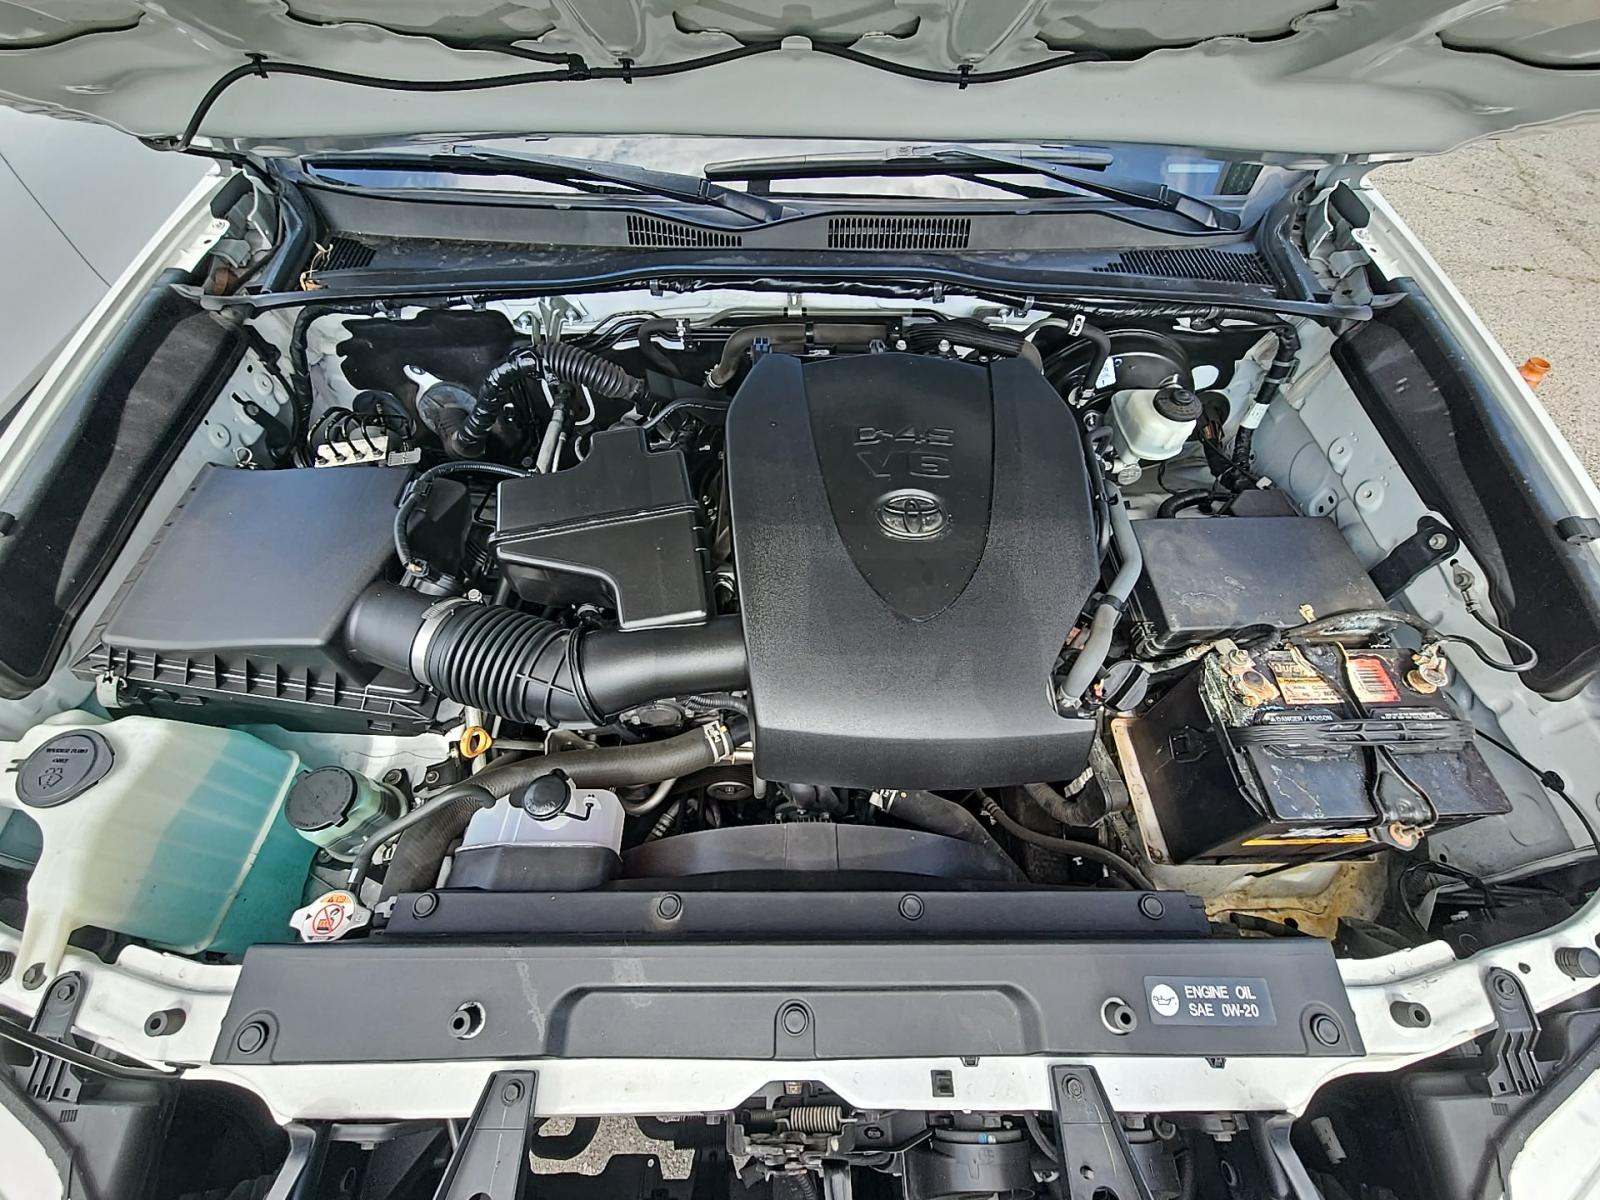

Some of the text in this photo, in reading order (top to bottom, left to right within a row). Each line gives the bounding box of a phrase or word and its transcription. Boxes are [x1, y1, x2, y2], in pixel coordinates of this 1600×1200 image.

[856, 450, 951, 478] V6
[1184, 985, 1257, 1000] ENGINE OIL
[1188, 1002, 1260, 1018] SAE 0W-20
